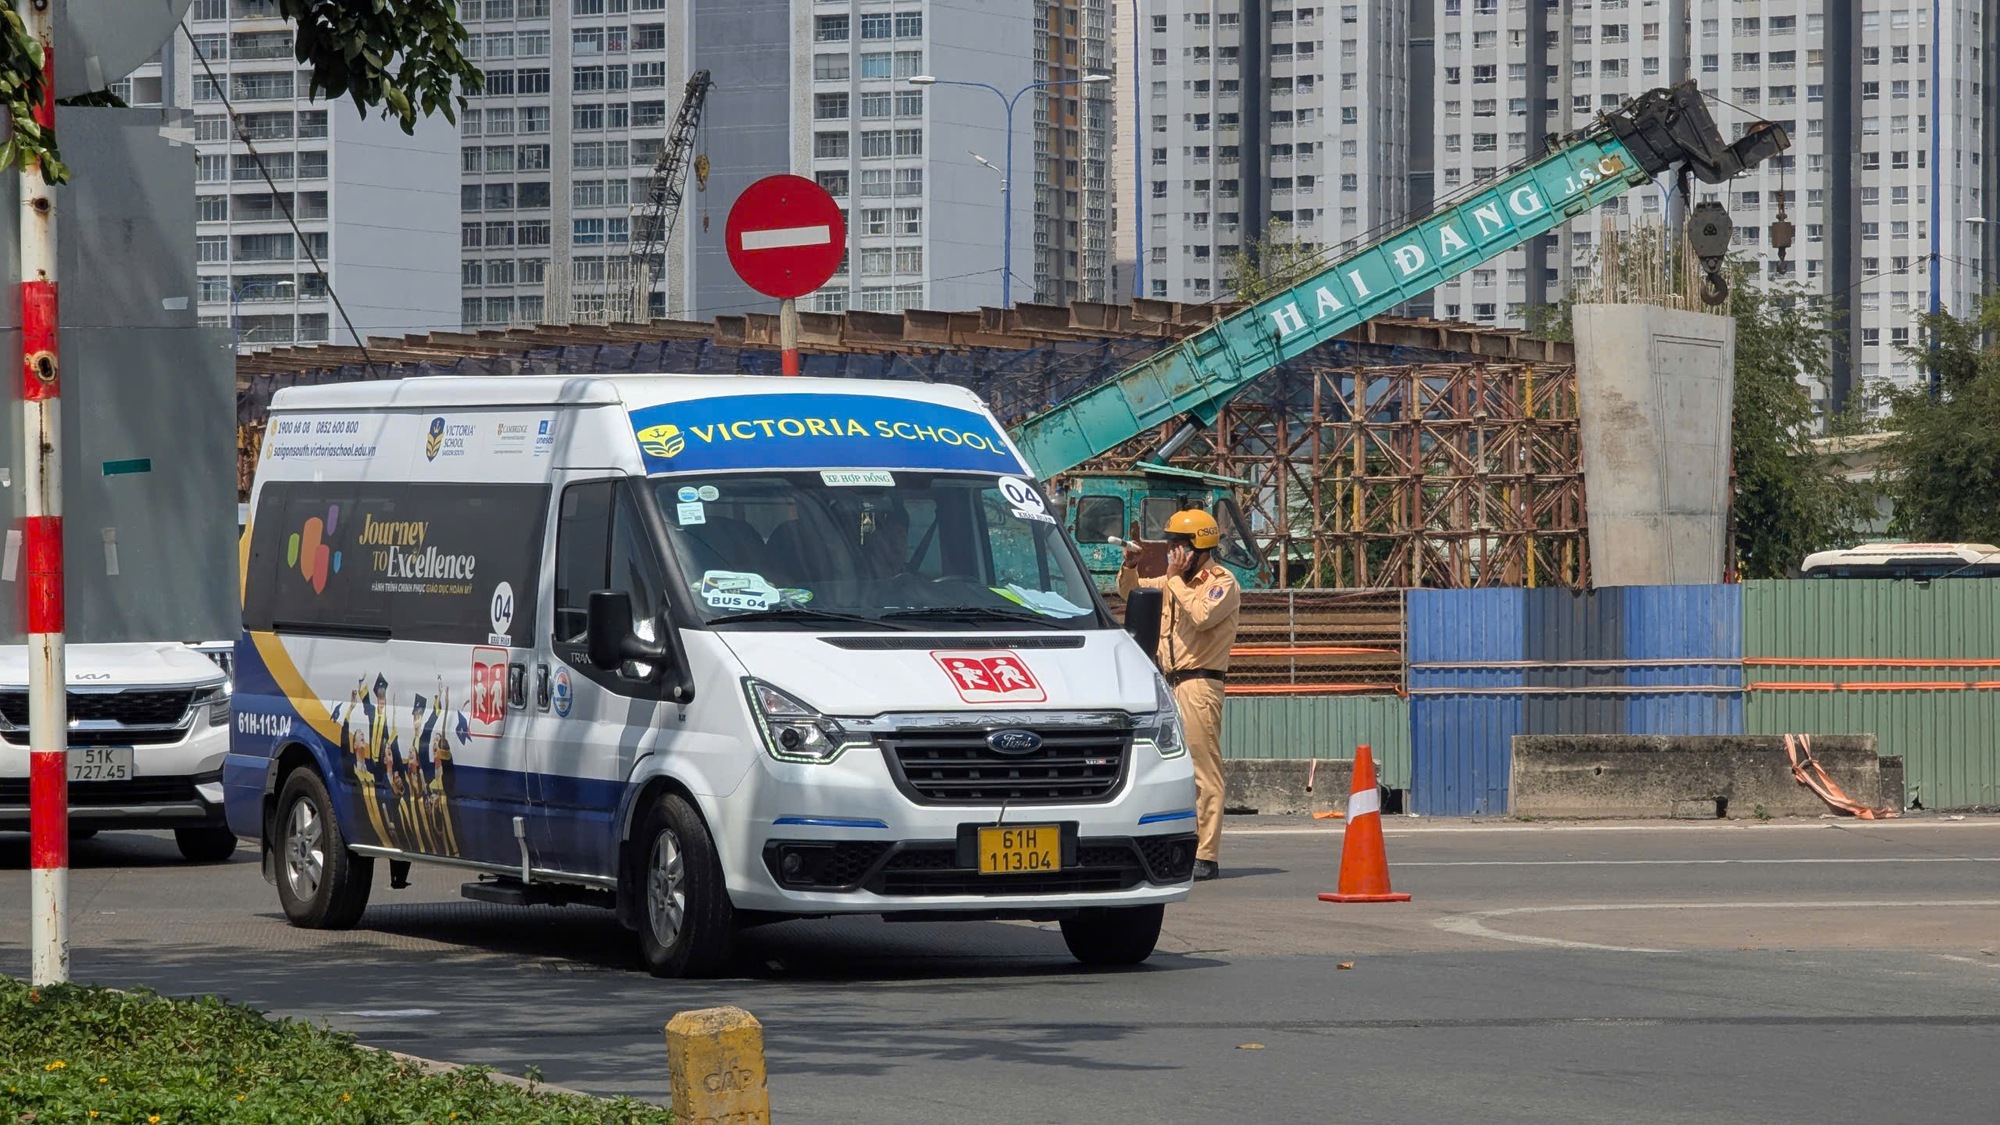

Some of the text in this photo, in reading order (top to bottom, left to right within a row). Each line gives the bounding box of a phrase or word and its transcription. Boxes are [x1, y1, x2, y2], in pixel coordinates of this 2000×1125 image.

[1270, 268, 1371, 338] HAI
[278, 421, 294, 434] 1900
[316, 421, 331, 433] 0852
[332, 421, 345, 433] 600
[346, 421, 359, 433] 800
[690, 418, 1005, 456] VICTORIA SCHOOL
[1005, 484, 1041, 507] 04
[359, 513, 428, 554] Journey
[373, 545, 475, 579] TO Excellence
[494, 594, 511, 623] 04
[711, 597, 766, 608] BUS 04
[238, 711, 292, 737] 61H-113.04
[1001, 733, 1032, 748] Ford
[85, 750, 113, 763] 51K
[74, 766, 125, 779] 727.45
[1003, 830, 1037, 848] 61H
[990, 852, 1051, 870] 113.04
